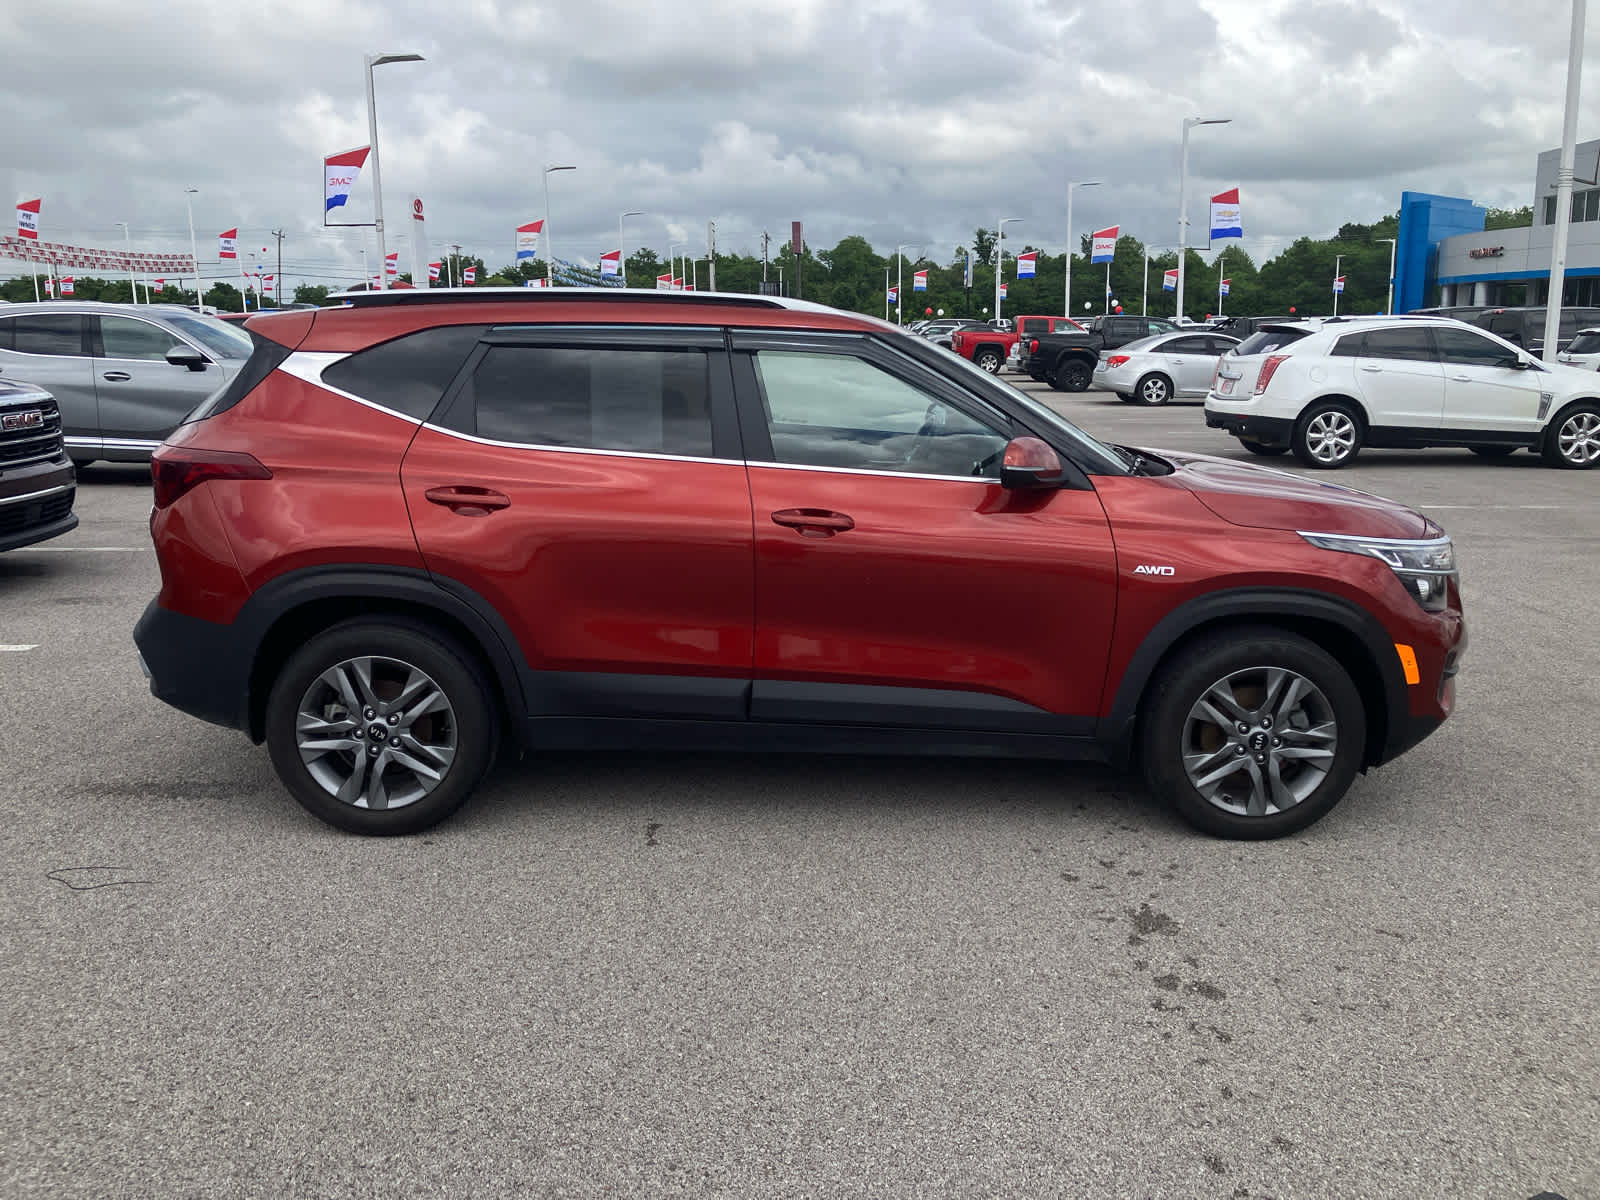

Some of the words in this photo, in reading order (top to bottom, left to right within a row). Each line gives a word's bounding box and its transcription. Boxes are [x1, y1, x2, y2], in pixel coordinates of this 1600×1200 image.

[3, 412, 43, 429] GMC
[1133, 564, 1175, 576] AWD
[370, 726, 386, 740] KIA
[1254, 734, 1264, 750] KIA
